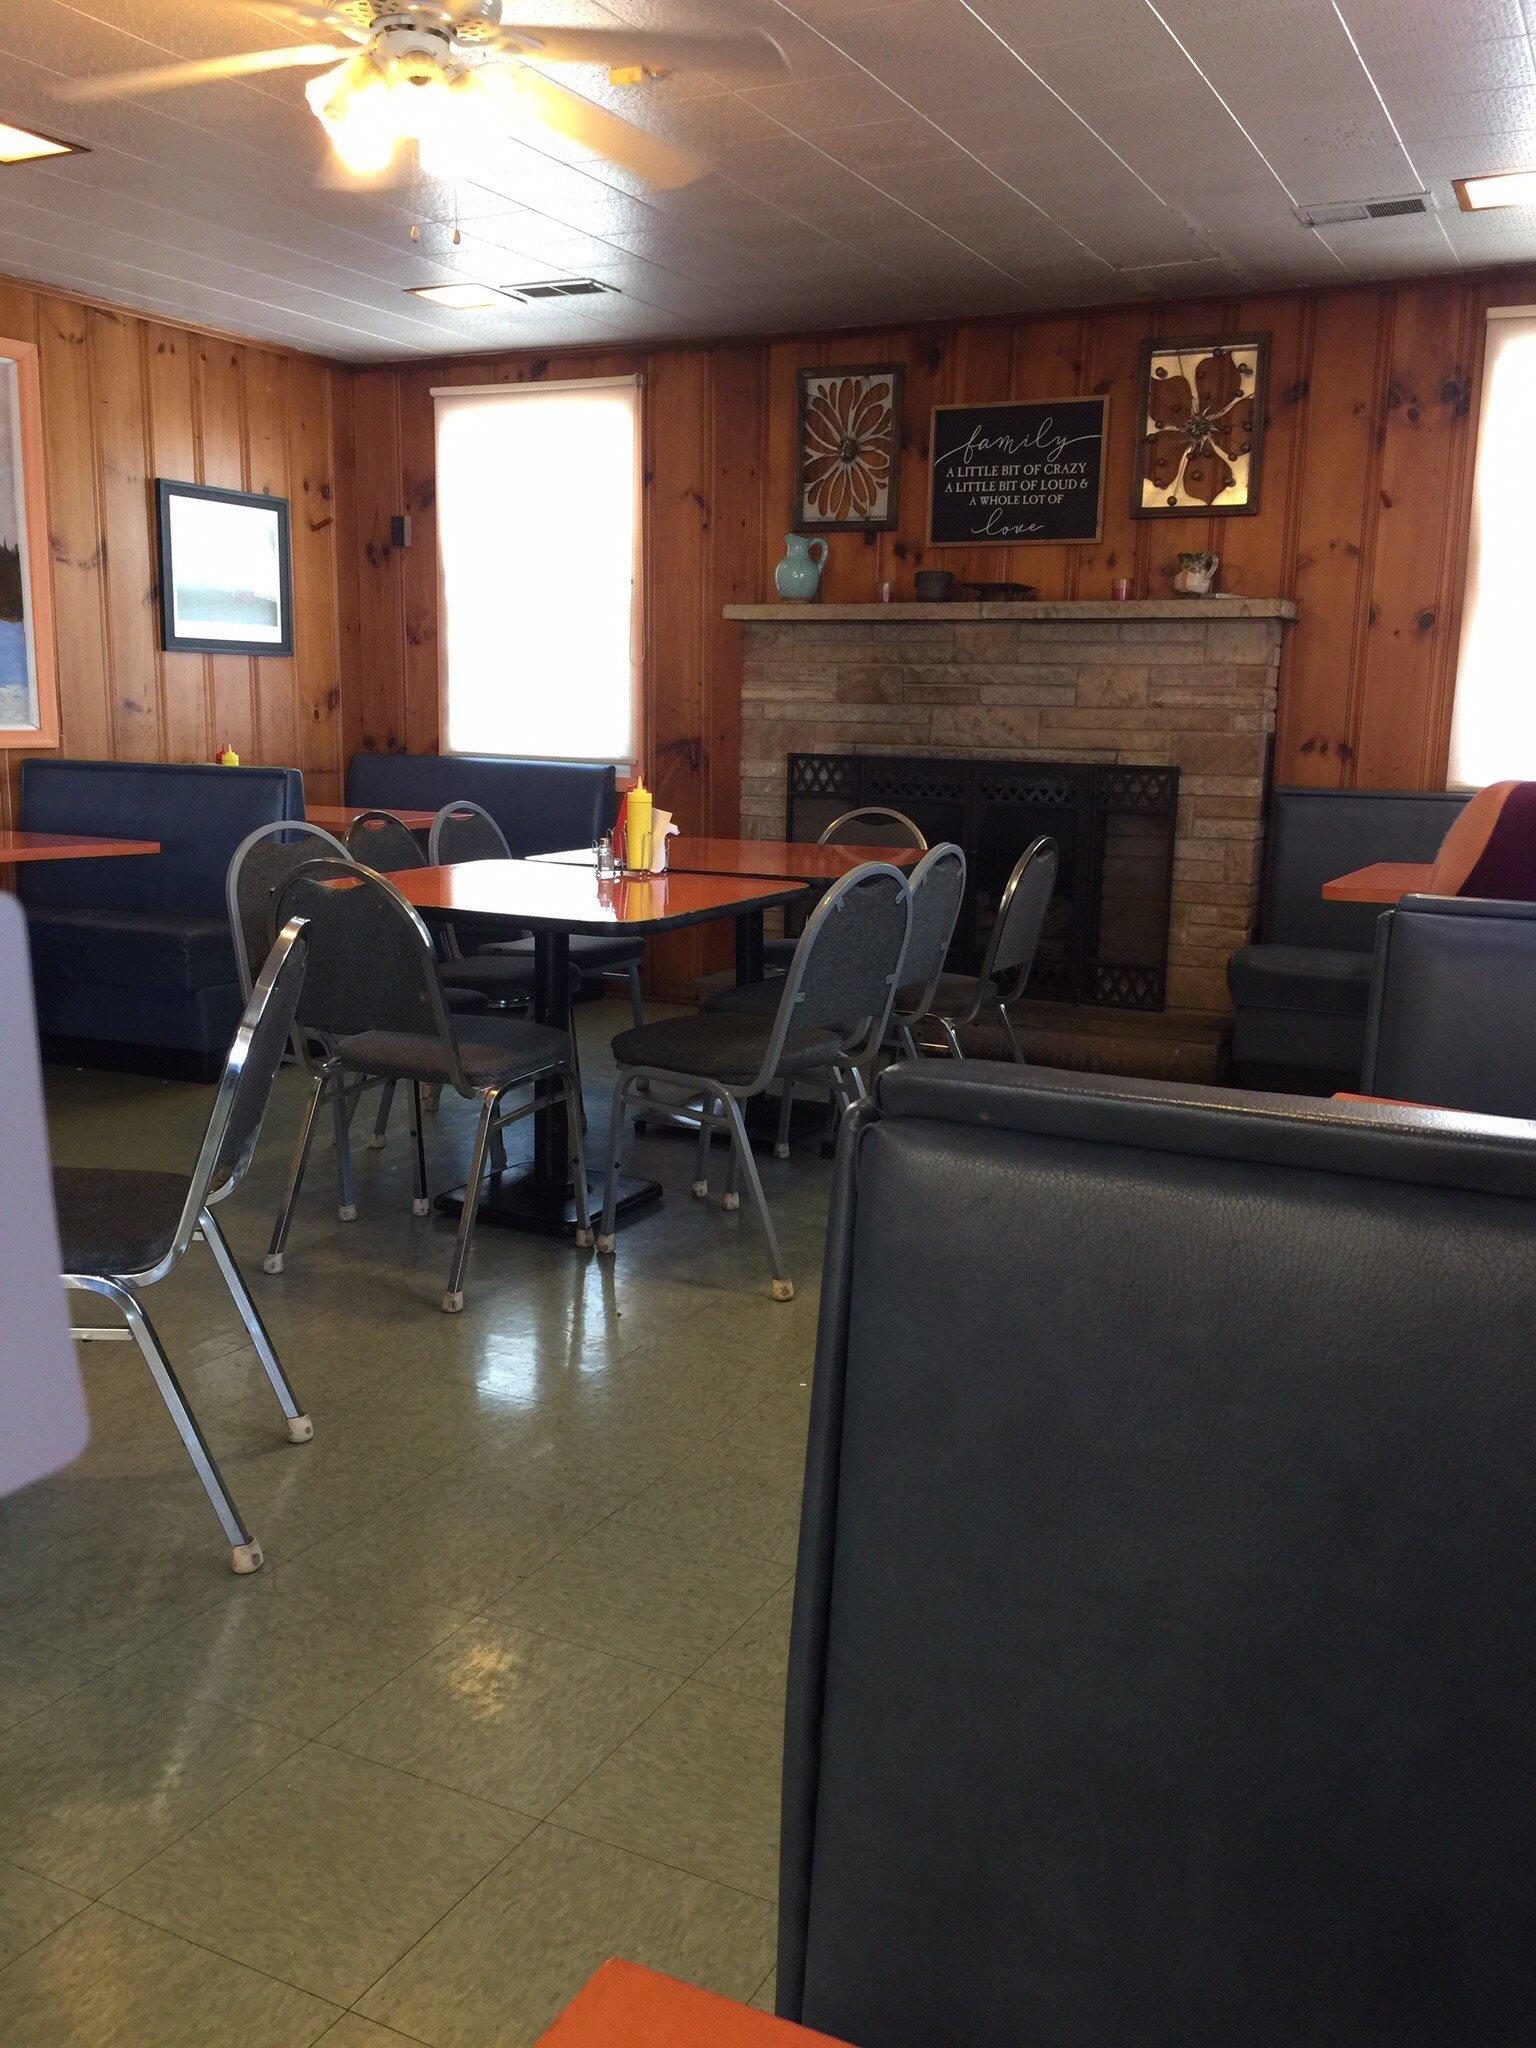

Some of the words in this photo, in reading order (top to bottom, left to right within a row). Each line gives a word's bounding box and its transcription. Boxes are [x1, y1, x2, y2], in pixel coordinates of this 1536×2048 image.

[934, 417, 1102, 465] family
[946, 468, 954, 478] A
[958, 466, 998, 477] LITTLE
[1002, 465, 1020, 476] BIT
[1024, 464, 1041, 475] OF
[1045, 463, 1087, 475] CRAZY
[945, 482, 952, 492] A
[956, 481, 995, 492] LITTLE
[999, 481, 1018, 491] BIT
[1020, 480, 1038, 491] OF
[1041, 480, 1077, 490] LOUD
[1080, 480, 1088, 489] &
[969, 497, 976, 506] A
[981, 496, 1020, 505] WHOLE
[1023, 495, 1045, 505] LOT
[1048, 494, 1064, 504] OF
[971, 508, 1044, 535] love
